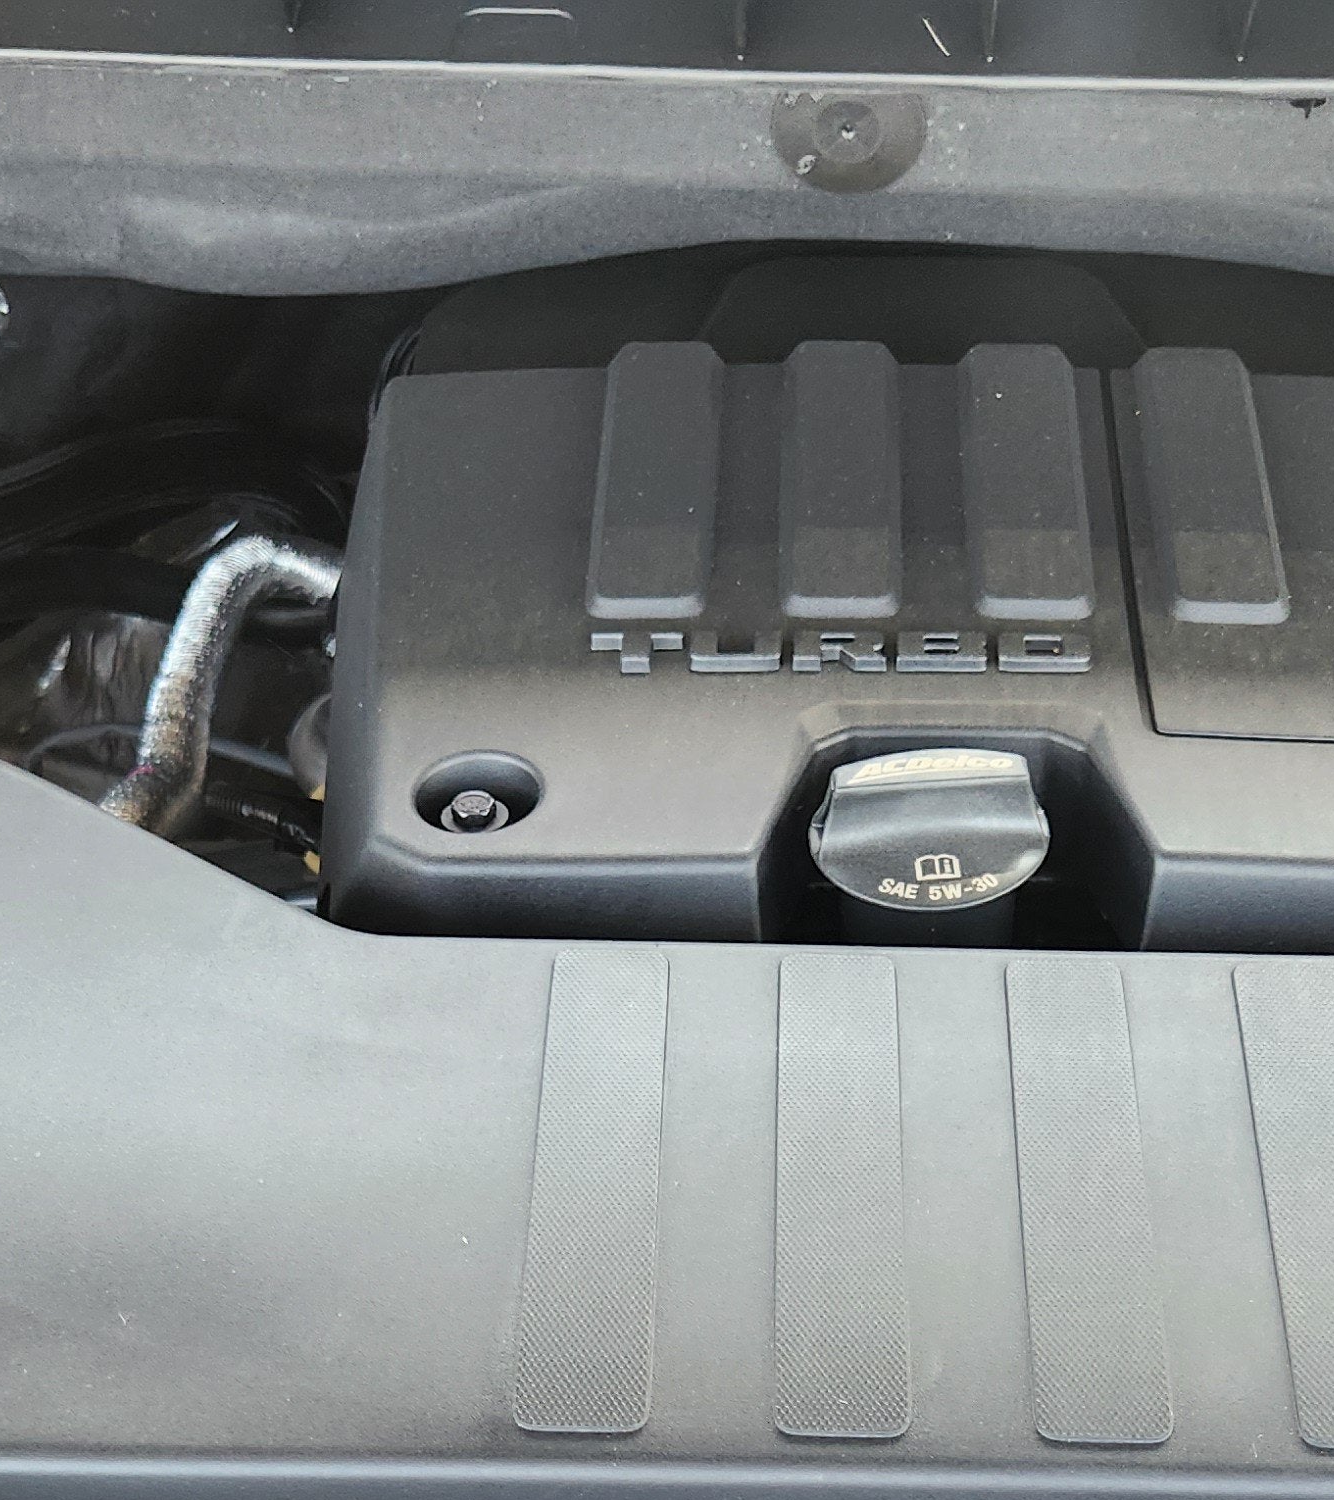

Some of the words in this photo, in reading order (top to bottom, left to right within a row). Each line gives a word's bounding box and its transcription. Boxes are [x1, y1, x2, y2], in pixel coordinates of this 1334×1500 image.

[590, 630, 1092, 673] TURBO
[846, 752, 1014, 784] ACDelco
[877, 876, 919, 900] SAE
[929, 871, 999, 901] 5W-30
